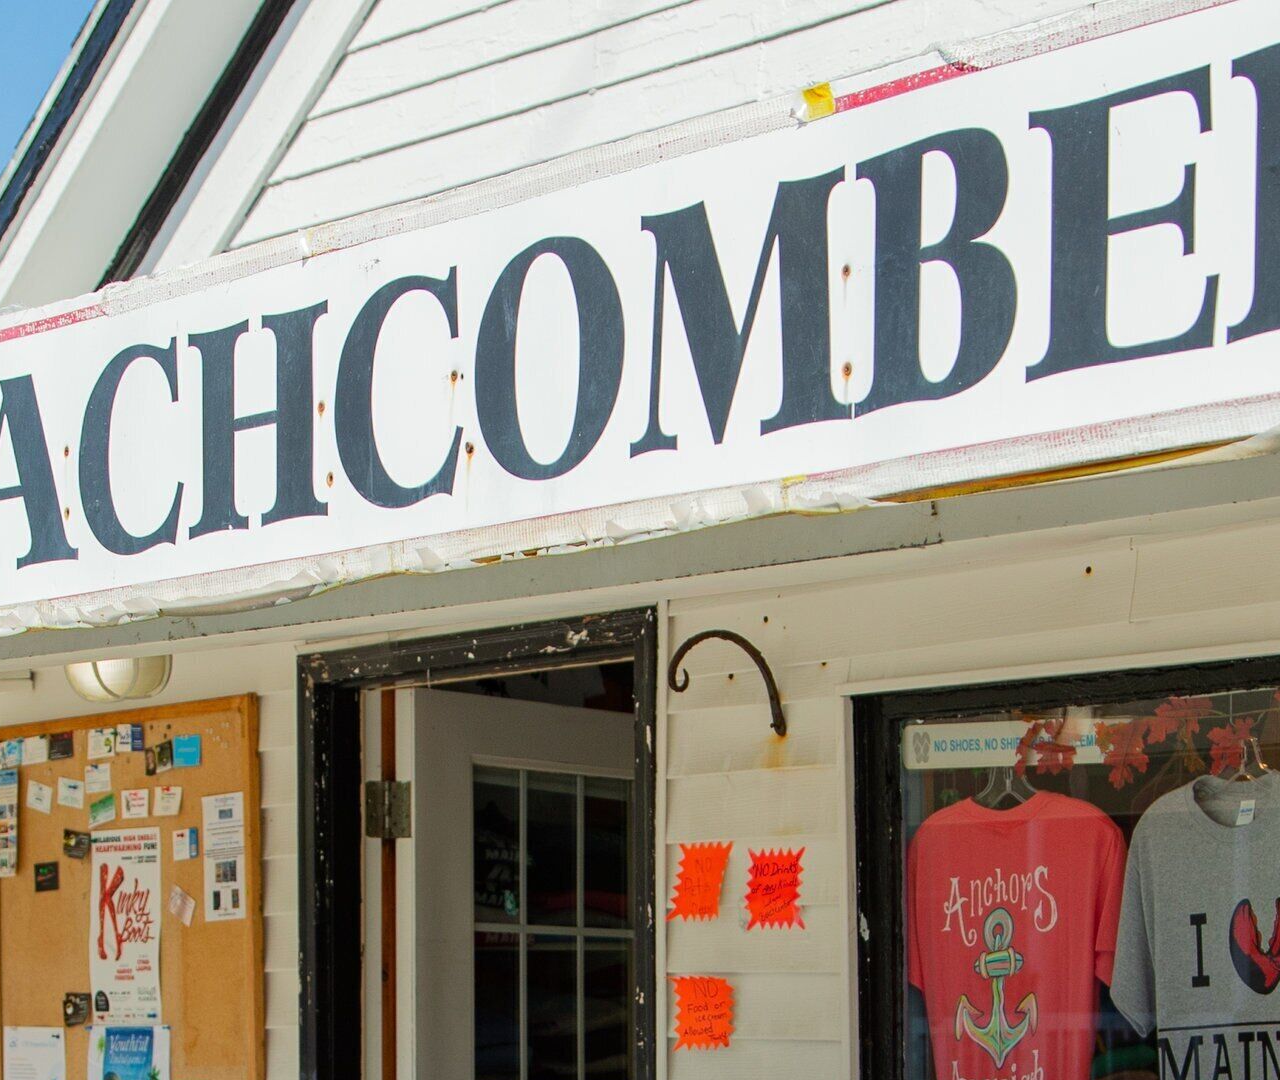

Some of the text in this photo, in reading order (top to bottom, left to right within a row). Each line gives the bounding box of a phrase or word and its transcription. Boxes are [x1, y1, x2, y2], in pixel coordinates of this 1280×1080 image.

[934, 739, 947, 752] NO
[950, 738, 983, 753] SHOES,
[985, 737, 998, 751] NO
[121, 917, 154, 944] Boots
[1190, 913, 1210, 988] I
[687, 1001, 709, 1014] Food
